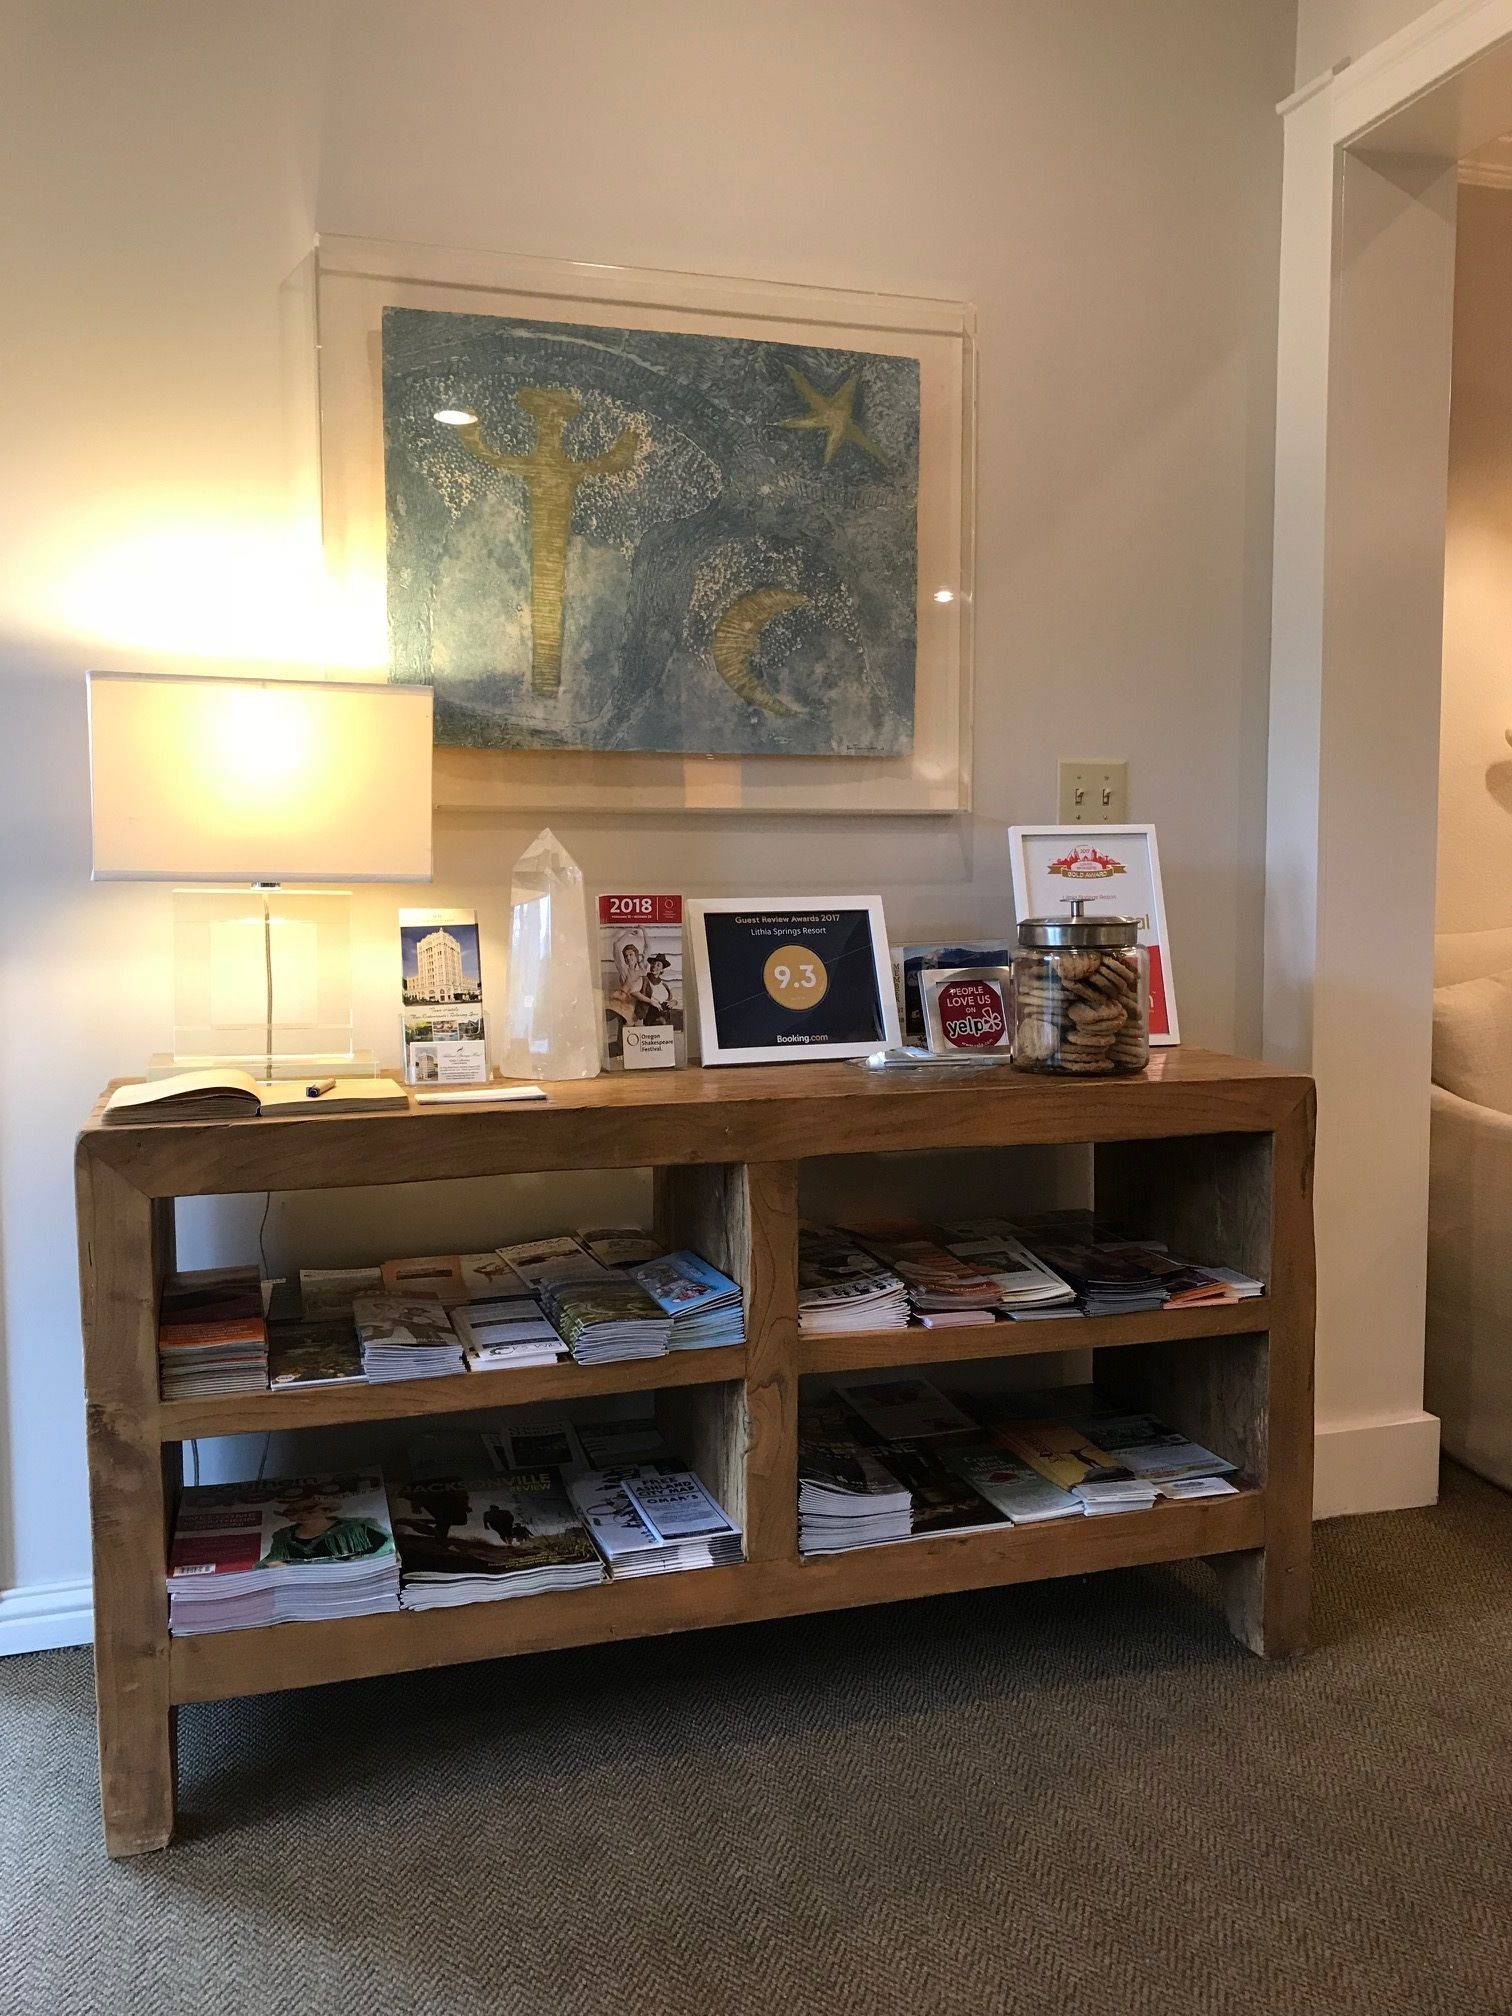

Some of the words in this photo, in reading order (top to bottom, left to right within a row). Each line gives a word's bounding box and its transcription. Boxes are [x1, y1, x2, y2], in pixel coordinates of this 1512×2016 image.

[610, 898, 652, 913] 2018
[735, 916, 760, 924] Guest
[791, 915, 820, 923] Awards
[820, 914, 840, 922] 2017
[750, 928, 772, 936] Lithia
[772, 927, 801, 937] Springs
[774, 964, 817, 989] 9.3
[949, 986, 984, 996] PEOPLE
[947, 996, 975, 1007] LOVE
[977, 995, 991, 1004] US
[946, 1015, 984, 1039] yelp
[776, 1034, 829, 1044] Booking.com
[642, 1476, 678, 1486] FREE
[637, 1481, 691, 1492] ASHLAND
[669, 1486, 695, 1494] MAP
[647, 1494, 698, 1504] OMAR'S
